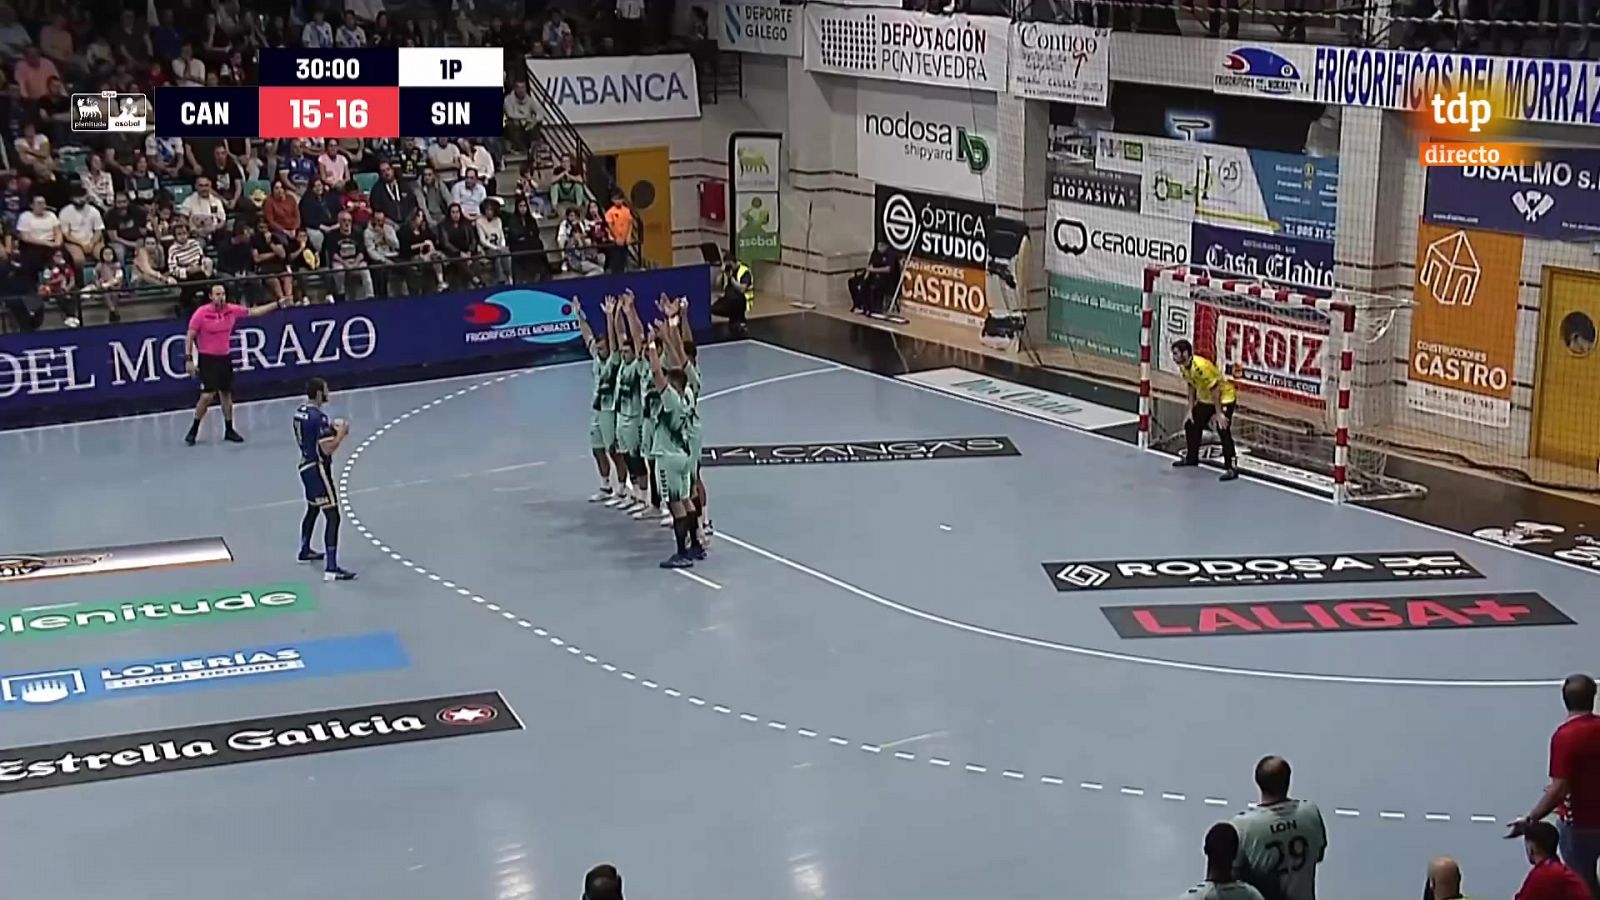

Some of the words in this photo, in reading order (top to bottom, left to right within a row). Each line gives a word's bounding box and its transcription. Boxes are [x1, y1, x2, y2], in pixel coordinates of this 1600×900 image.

[745, 5, 793, 23] DEPORTE
[745, 24, 788, 42] GALEGO
[881, 21, 987, 54] DEPUTACIÓN
[881, 48, 988, 81] PONTEVEDRA
[557, 72, 688, 105] ABANCA
[865, 111, 952, 146] nodosa
[904, 142, 952, 161] shipyard
[1463, 160, 1572, 187] DISALMO
[1053, 183, 1126, 207] BIOPASIVA
[921, 203, 986, 239] ÓPTICA
[921, 231, 986, 263] STUDIO
[1091, 230, 1188, 263] CERQUEIRO
[1206, 243, 1258, 277] Casa
[1265, 253, 1335, 290] Eladio
[901, 271, 985, 314] CASTRO
[1225, 320, 1323, 380] FROIZ
[1414, 352, 1507, 390] CASTRO
[772, 438, 1004, 458] CANGAS
[1116, 557, 1374, 579] RODOSA
[1189, 572, 1324, 583] ALPINE
[1132, 599, 1530, 634] LALIGA+
[101, 648, 301, 681] LOTERÍAS
[0, 739, 219, 782] Estrella
[227, 714, 426, 751] Galicia
[1270, 819, 1297, 835] LON
[1265, 835, 1309, 874] 29
